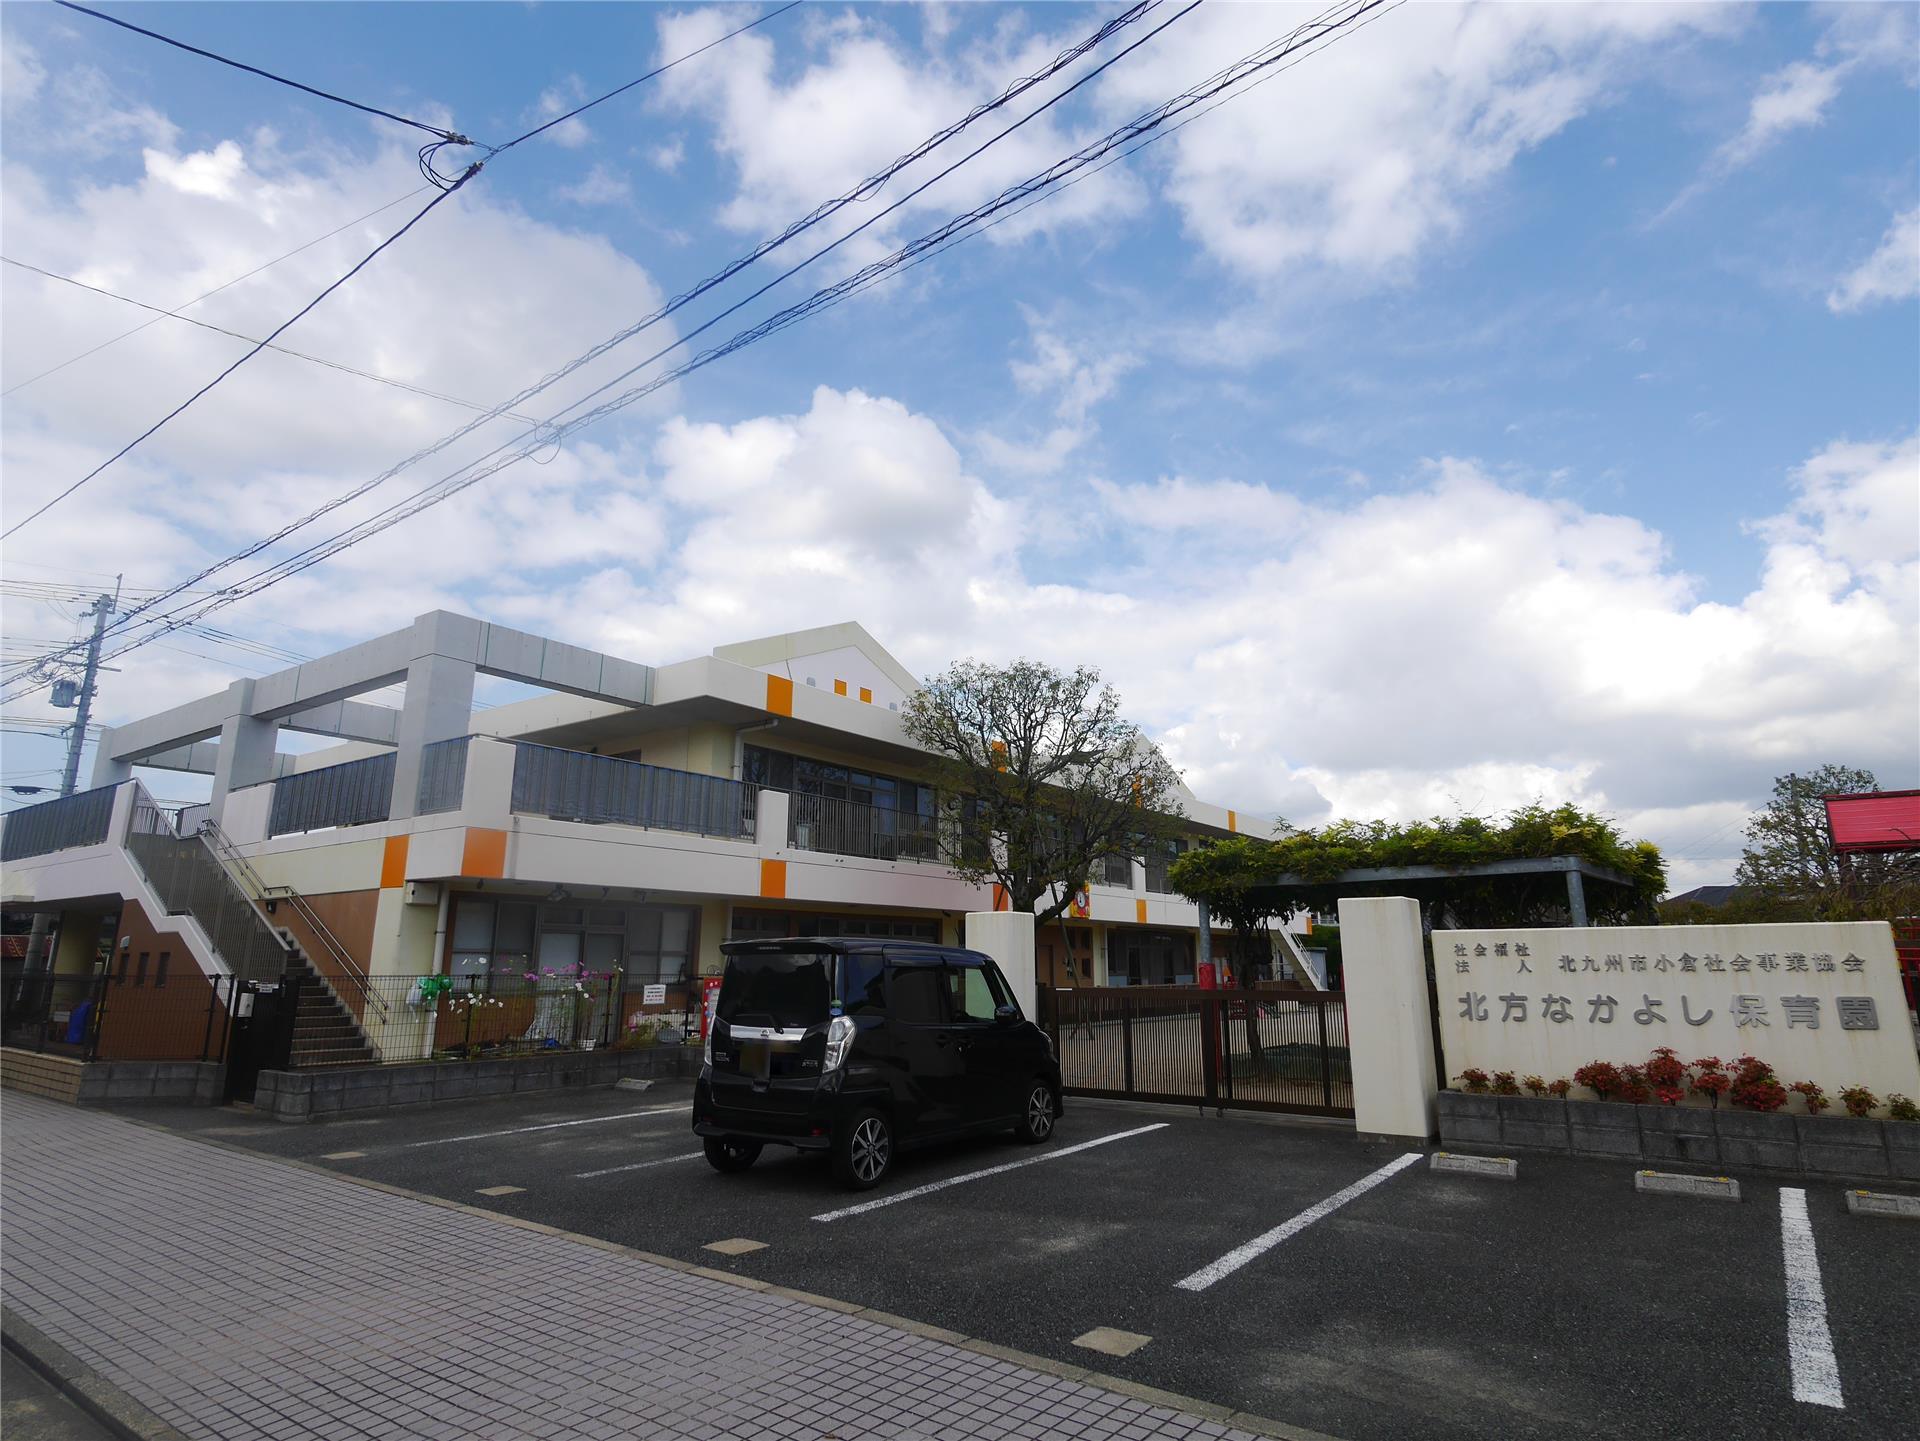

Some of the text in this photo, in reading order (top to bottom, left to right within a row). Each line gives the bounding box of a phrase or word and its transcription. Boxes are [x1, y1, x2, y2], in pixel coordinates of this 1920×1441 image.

[1454, 943, 1530, 957] 社会福祉
[1558, 952, 1867, 973] 北九州市小倉社会事業協会
[1458, 991, 1880, 1031] 北方なかよし保育園
